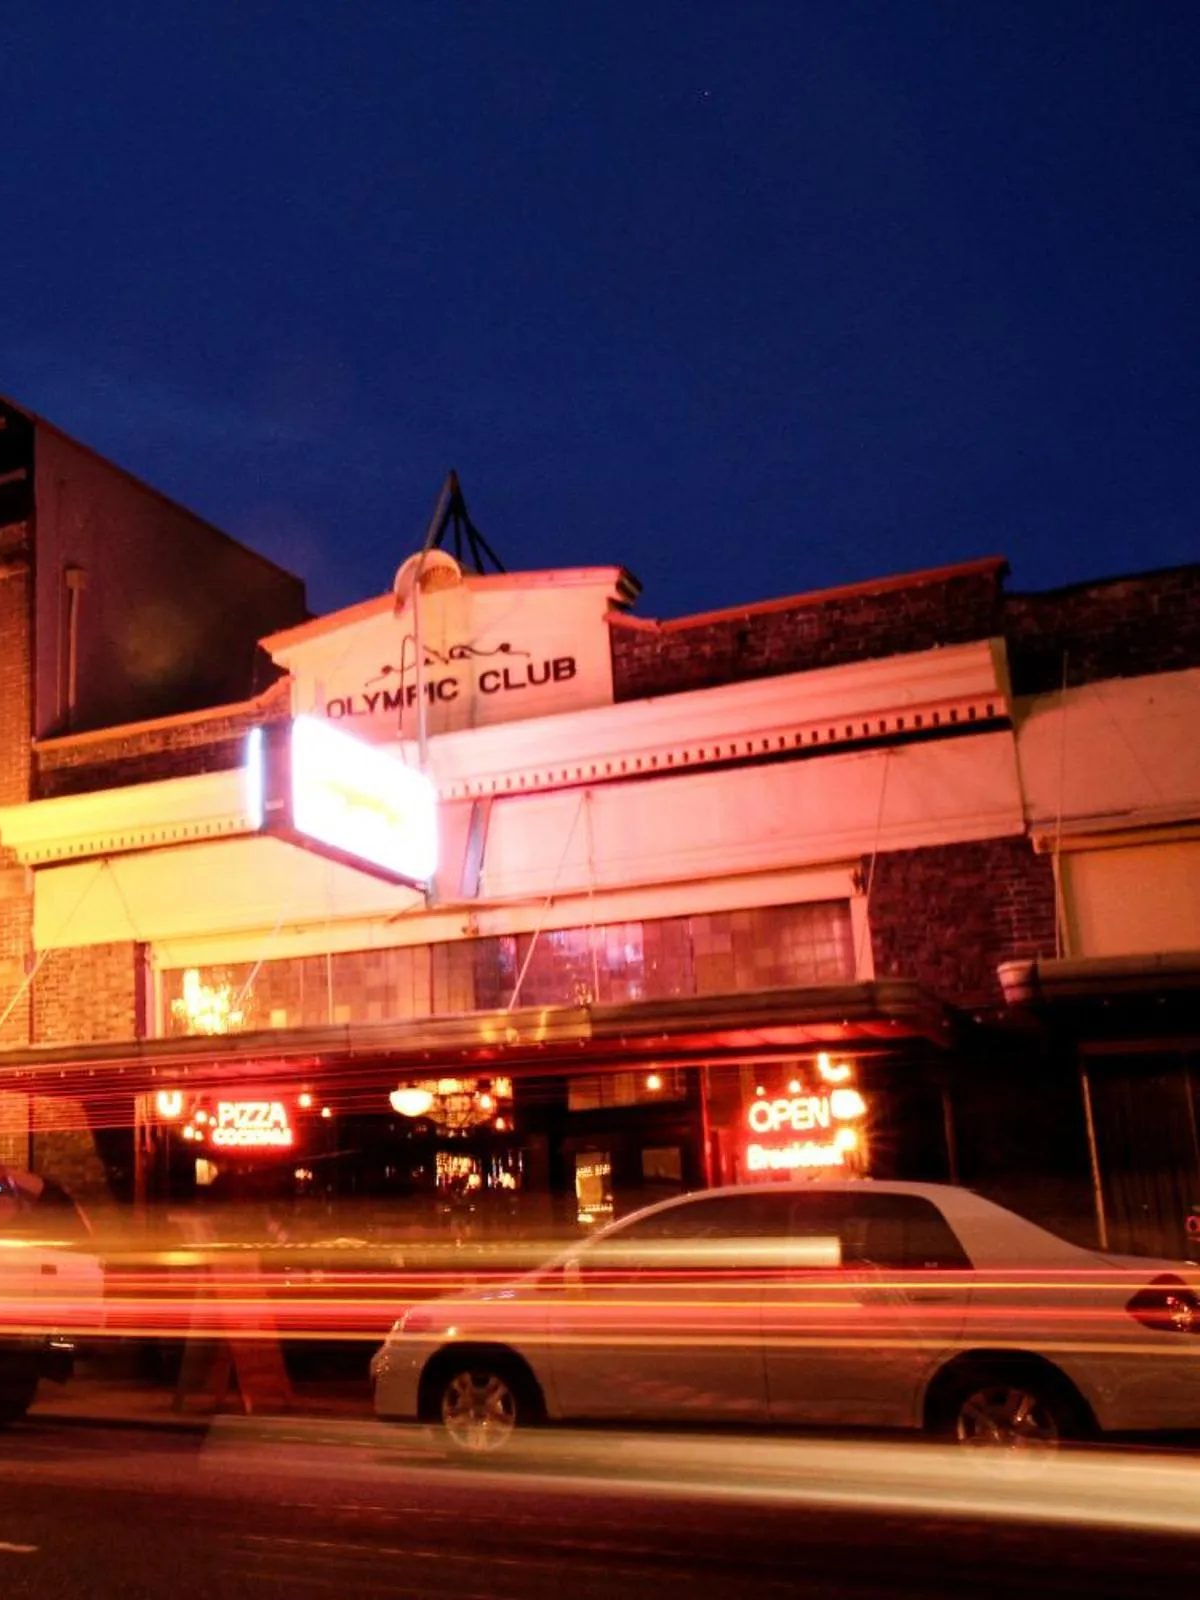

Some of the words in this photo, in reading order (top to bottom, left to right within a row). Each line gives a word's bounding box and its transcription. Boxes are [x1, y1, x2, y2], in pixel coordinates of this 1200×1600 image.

[327, 677, 459, 719] OLYMPIC
[478, 656, 577, 694] CLUB
[217, 1101, 288, 1128] PIZZA
[748, 1096, 831, 1133] OPEN
